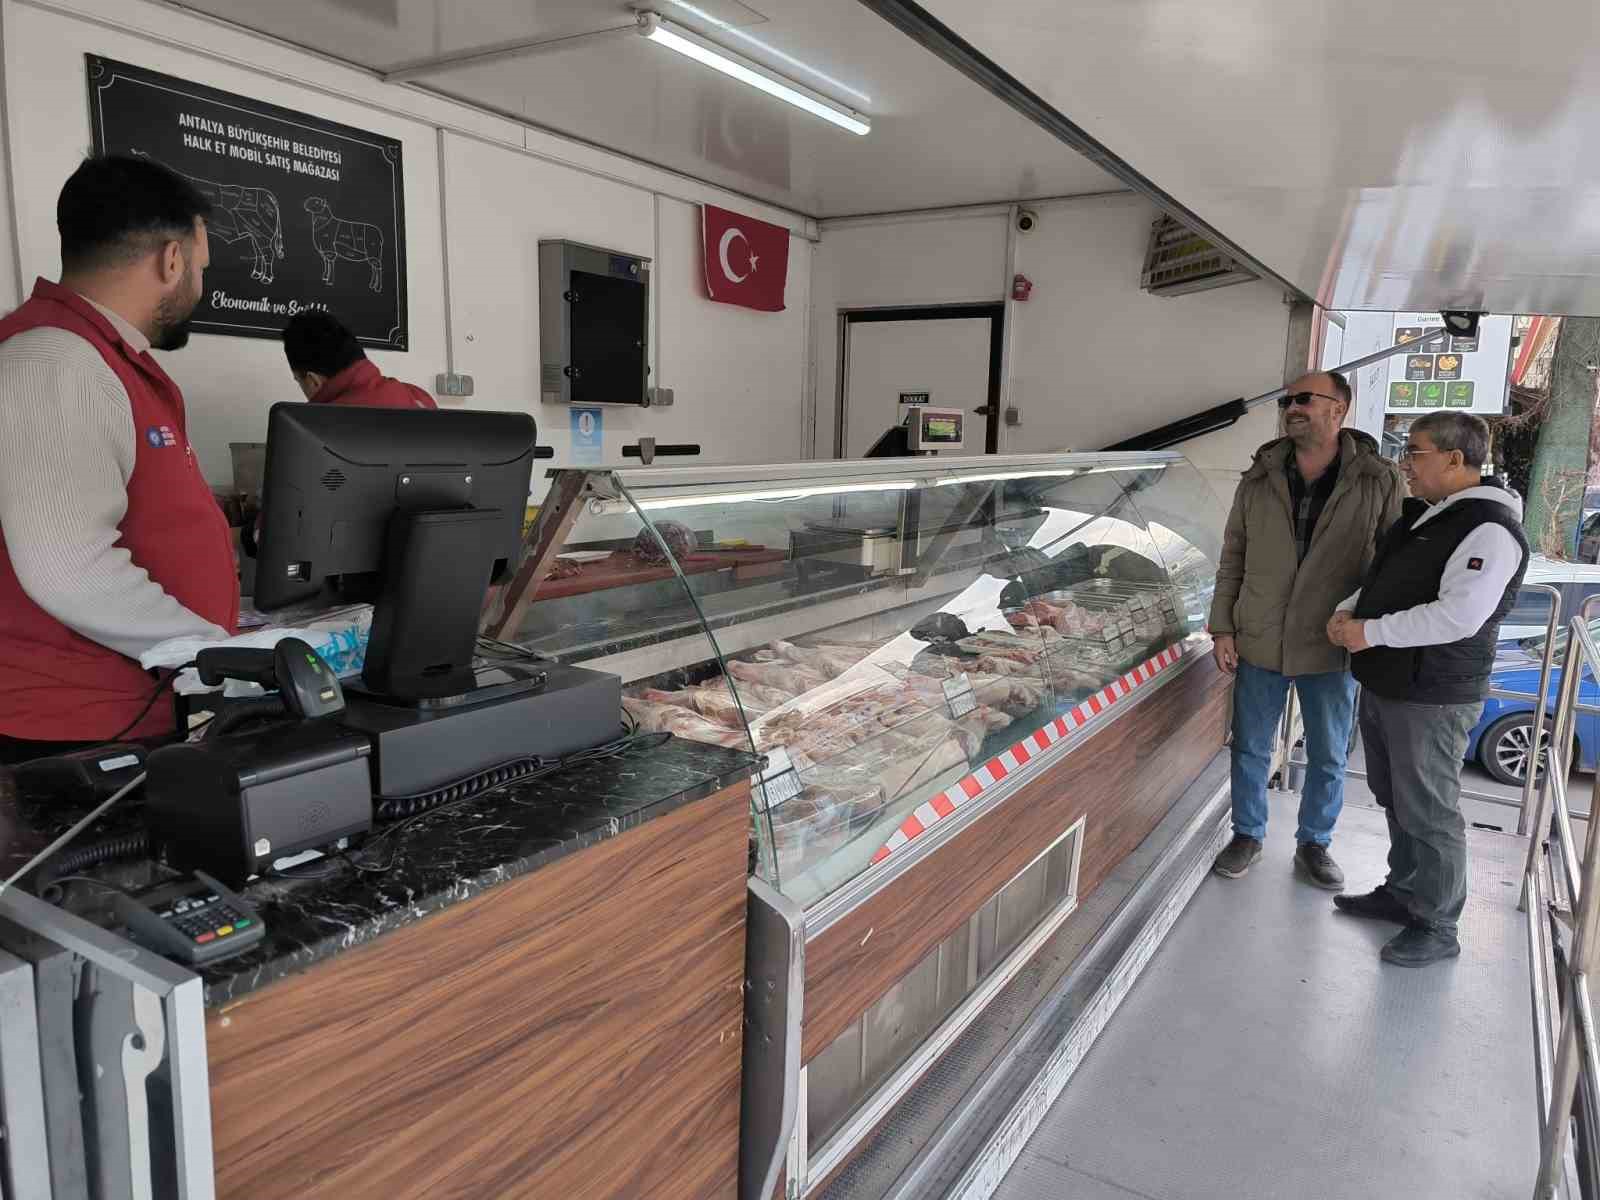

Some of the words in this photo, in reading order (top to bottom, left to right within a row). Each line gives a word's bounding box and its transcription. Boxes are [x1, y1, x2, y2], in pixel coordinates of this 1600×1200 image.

[178, 113, 225, 136] ANTALYA
[227, 124, 290, 152] BÜYÜKŞEHİR
[292, 142, 342, 165] BELEDİYESİ
[183, 134, 212, 152] HALK
[215, 143, 226, 155] ET
[229, 145, 263, 164] MOBİL
[265, 153, 290, 173] SATIŞ
[293, 160, 340, 181] MAĞAZASI
[211, 290, 271, 313] Ekonomik
[273, 303, 287, 314] ve
